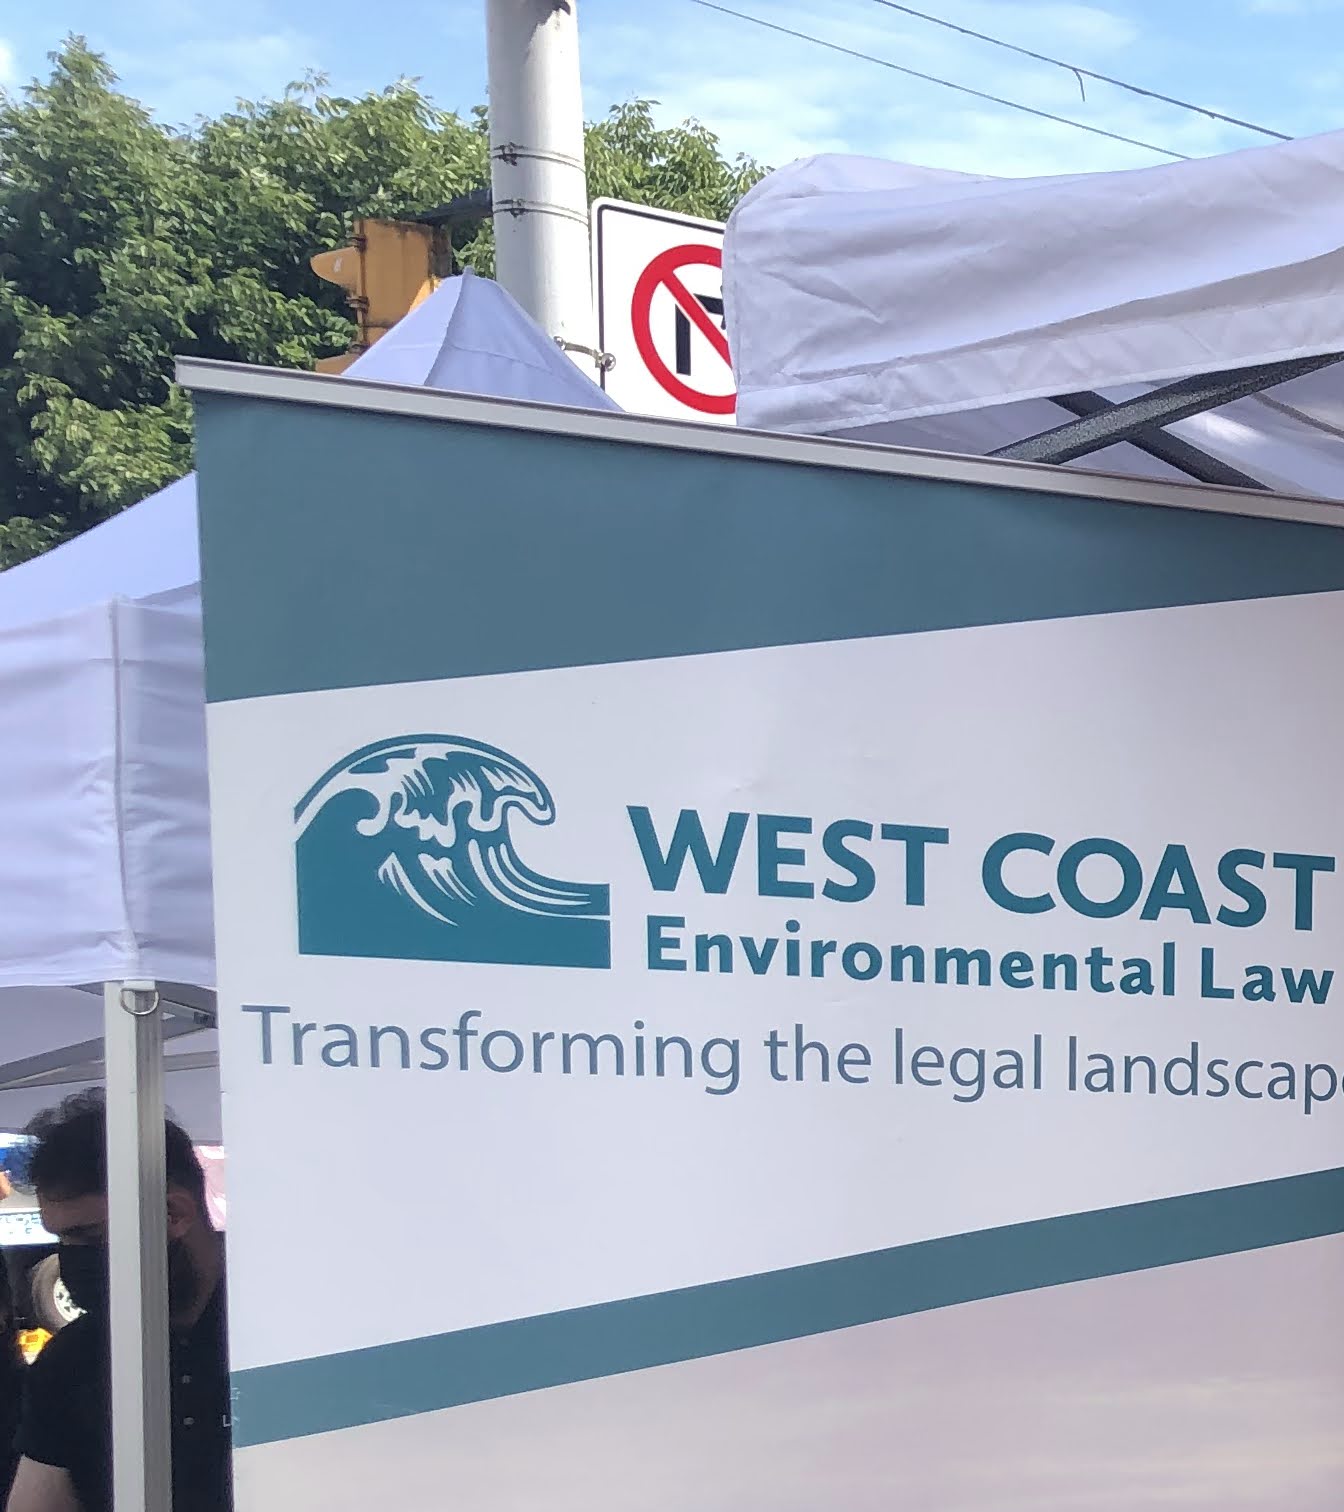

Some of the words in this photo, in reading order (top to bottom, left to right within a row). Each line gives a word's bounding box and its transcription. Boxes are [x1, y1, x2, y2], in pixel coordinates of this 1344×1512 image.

[627, 805, 950, 908] WEST
[980, 832, 1336, 932] COAST
[647, 915, 1178, 997] Environmental
[1200, 946, 1335, 1006] Law
[241, 1005, 741, 1096] Transforming
[764, 1024, 873, 1088] the
[894, 1028, 1041, 1105] legal
